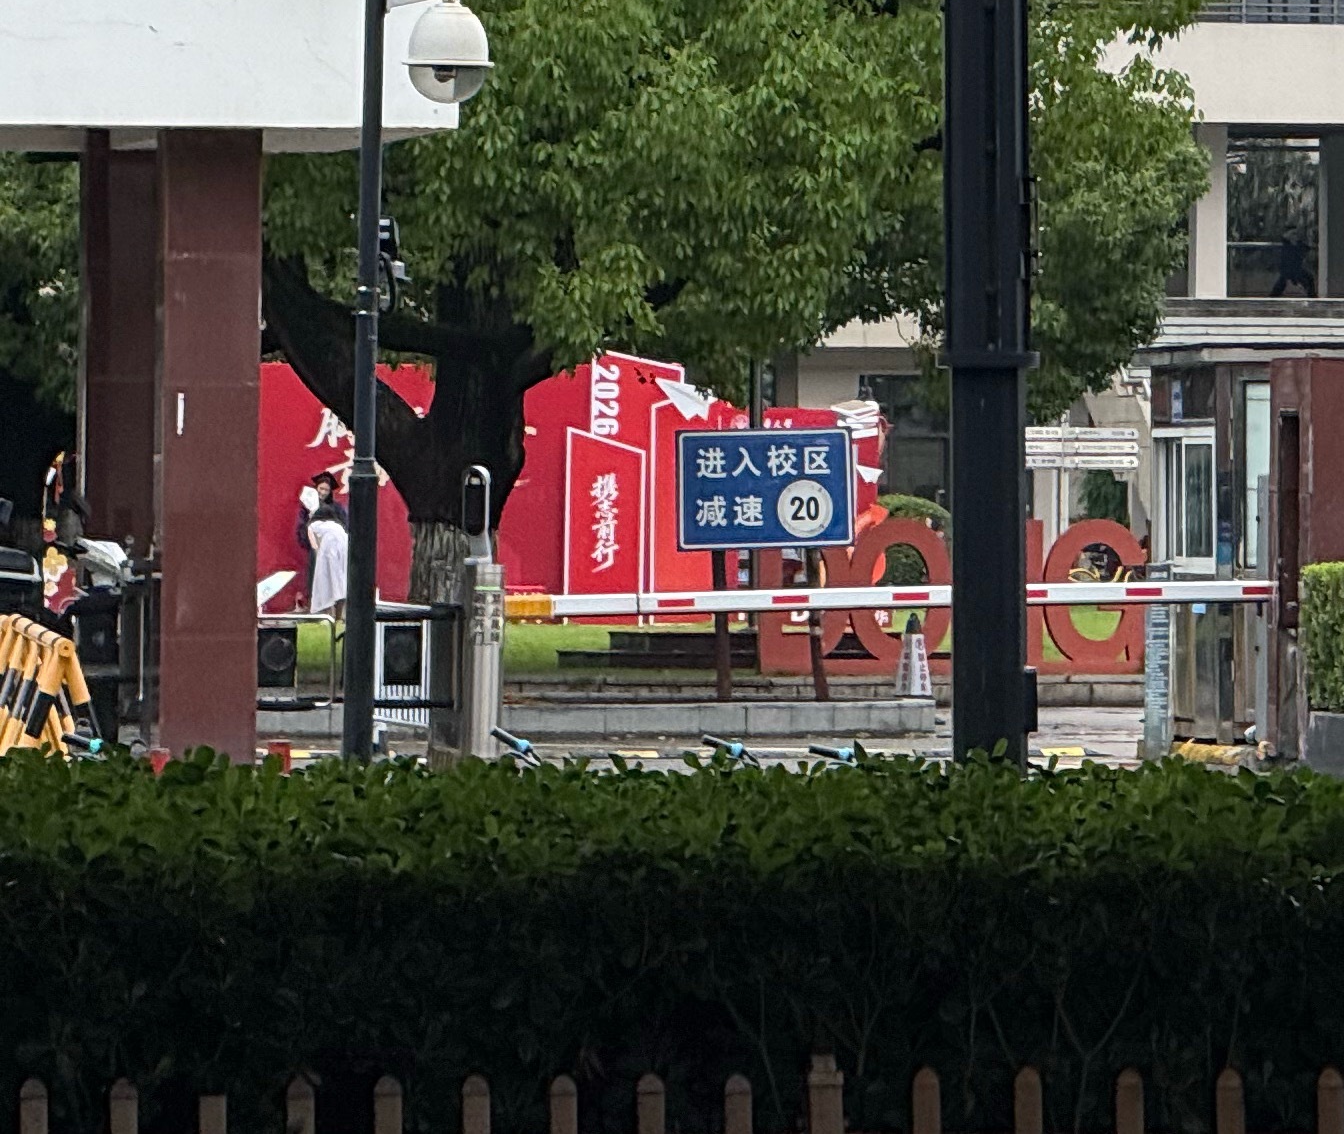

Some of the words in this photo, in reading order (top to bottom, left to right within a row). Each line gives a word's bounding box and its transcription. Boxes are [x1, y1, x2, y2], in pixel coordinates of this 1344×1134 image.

[594, 365, 620, 436] 2026
[696, 444, 832, 479] 进入校区
[590, 472, 621, 573] 携志前行
[695, 495, 764, 528] 减速
[789, 496, 821, 521] 20
